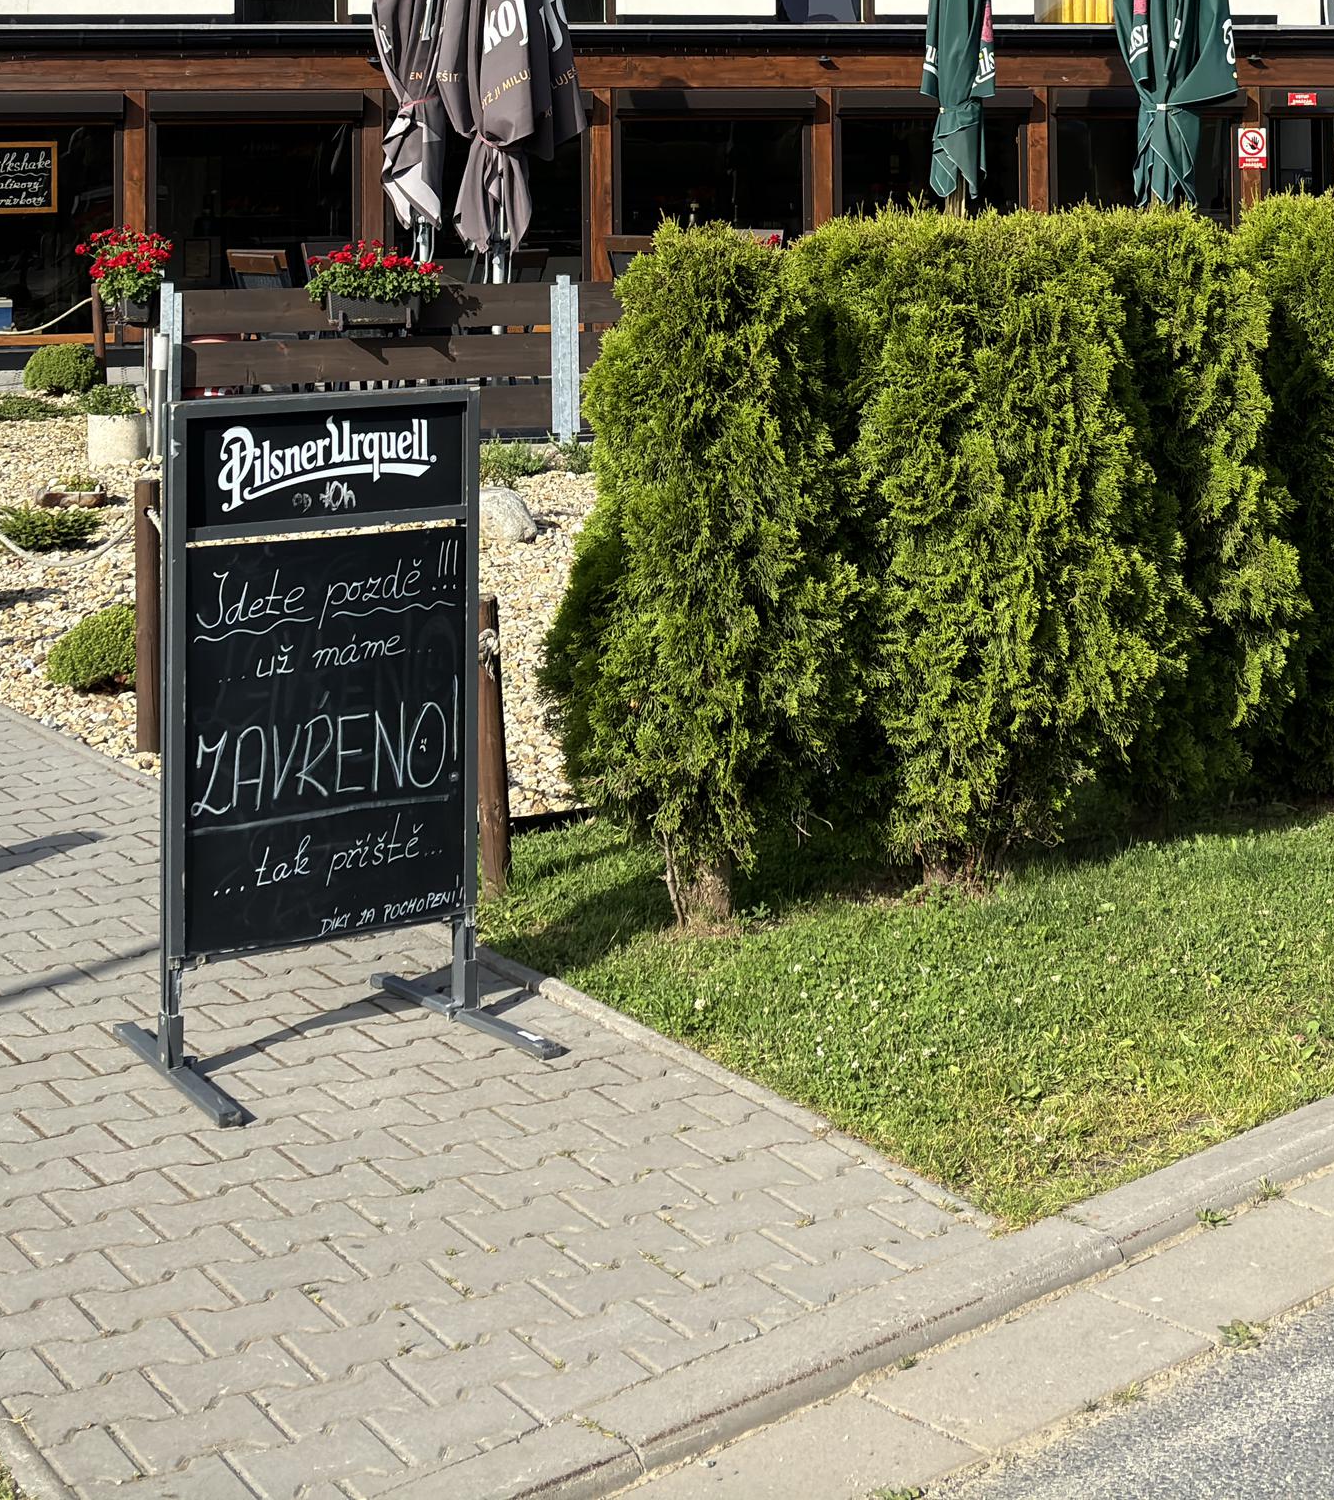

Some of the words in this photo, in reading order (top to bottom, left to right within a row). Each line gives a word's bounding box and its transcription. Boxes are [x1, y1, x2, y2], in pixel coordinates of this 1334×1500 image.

[218, 426, 331, 512] Pilsner
[326, 416, 429, 482] Urquell
[318, 558, 422, 630] pozdě
[320, 907, 351, 936] DÍKY
[356, 908, 375, 927] ZA
